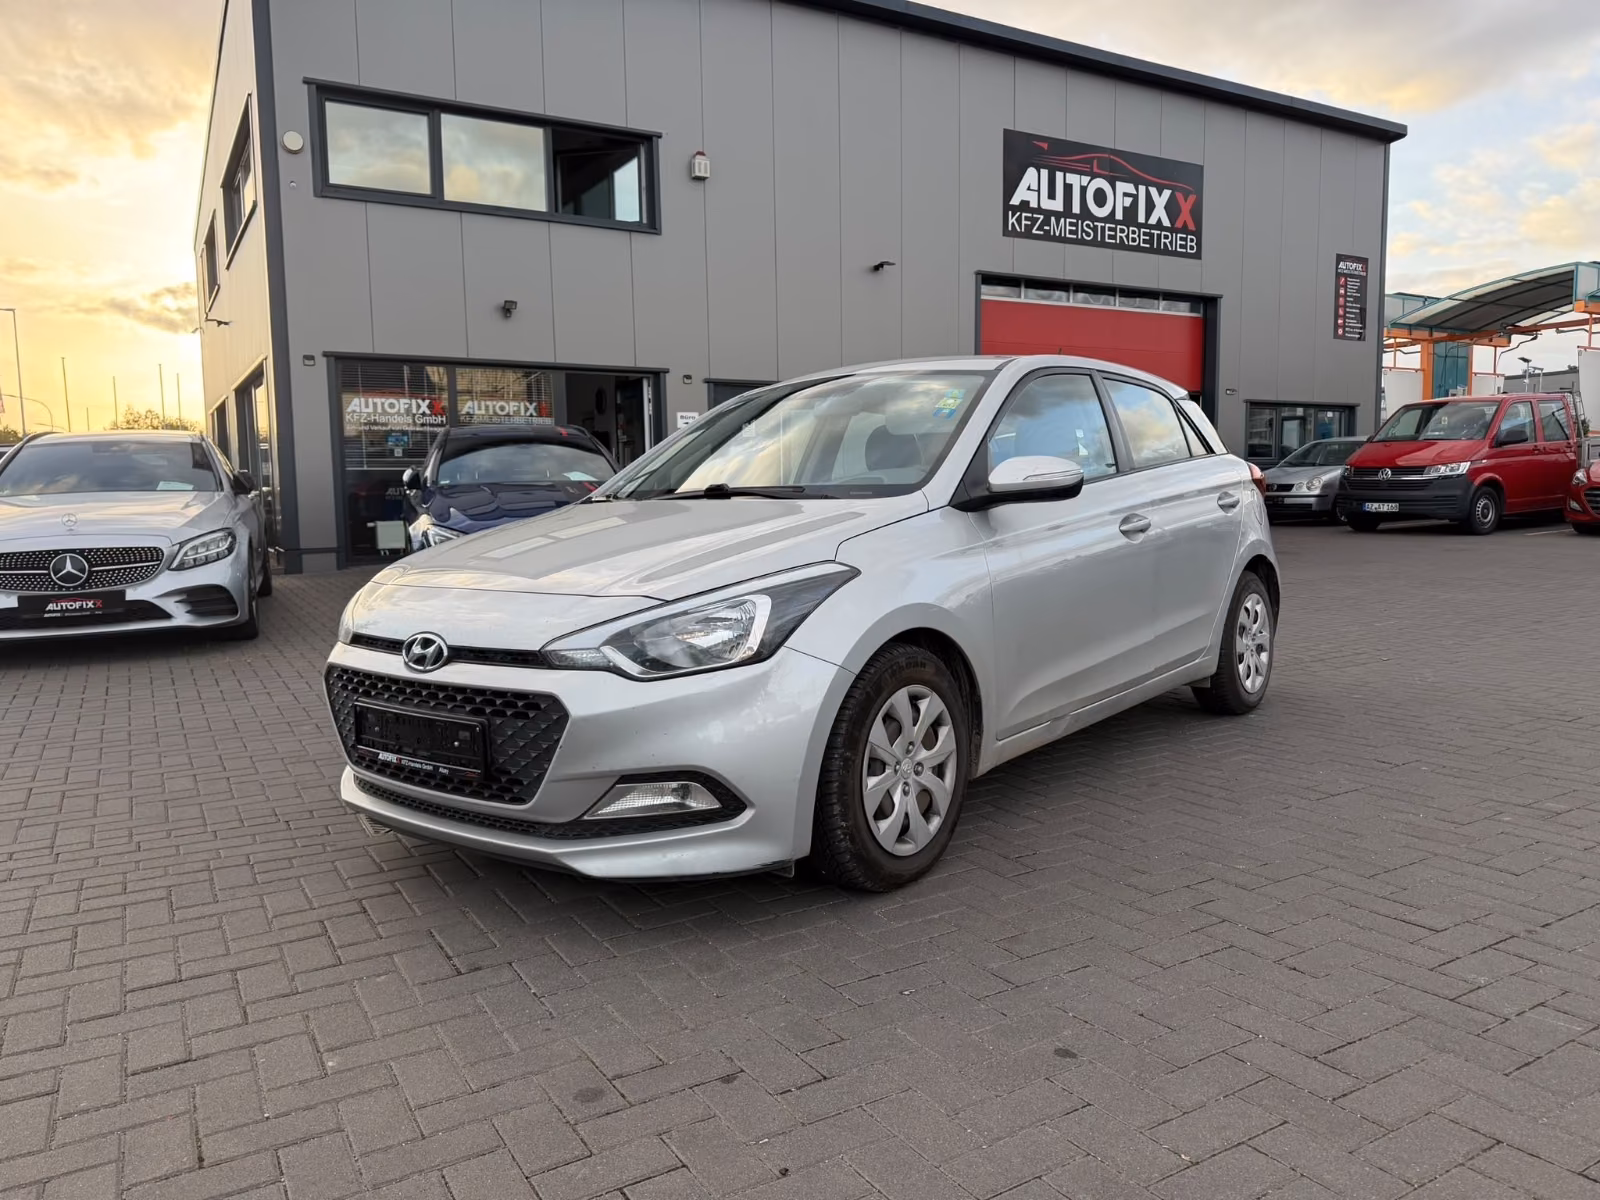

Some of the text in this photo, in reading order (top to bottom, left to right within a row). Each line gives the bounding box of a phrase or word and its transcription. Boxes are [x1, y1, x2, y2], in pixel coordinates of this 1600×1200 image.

[1008, 210, 1197, 254] KFZ-MEISTERBETRIEB
[345, 413, 446, 425] KFZ-Handels GmbH
